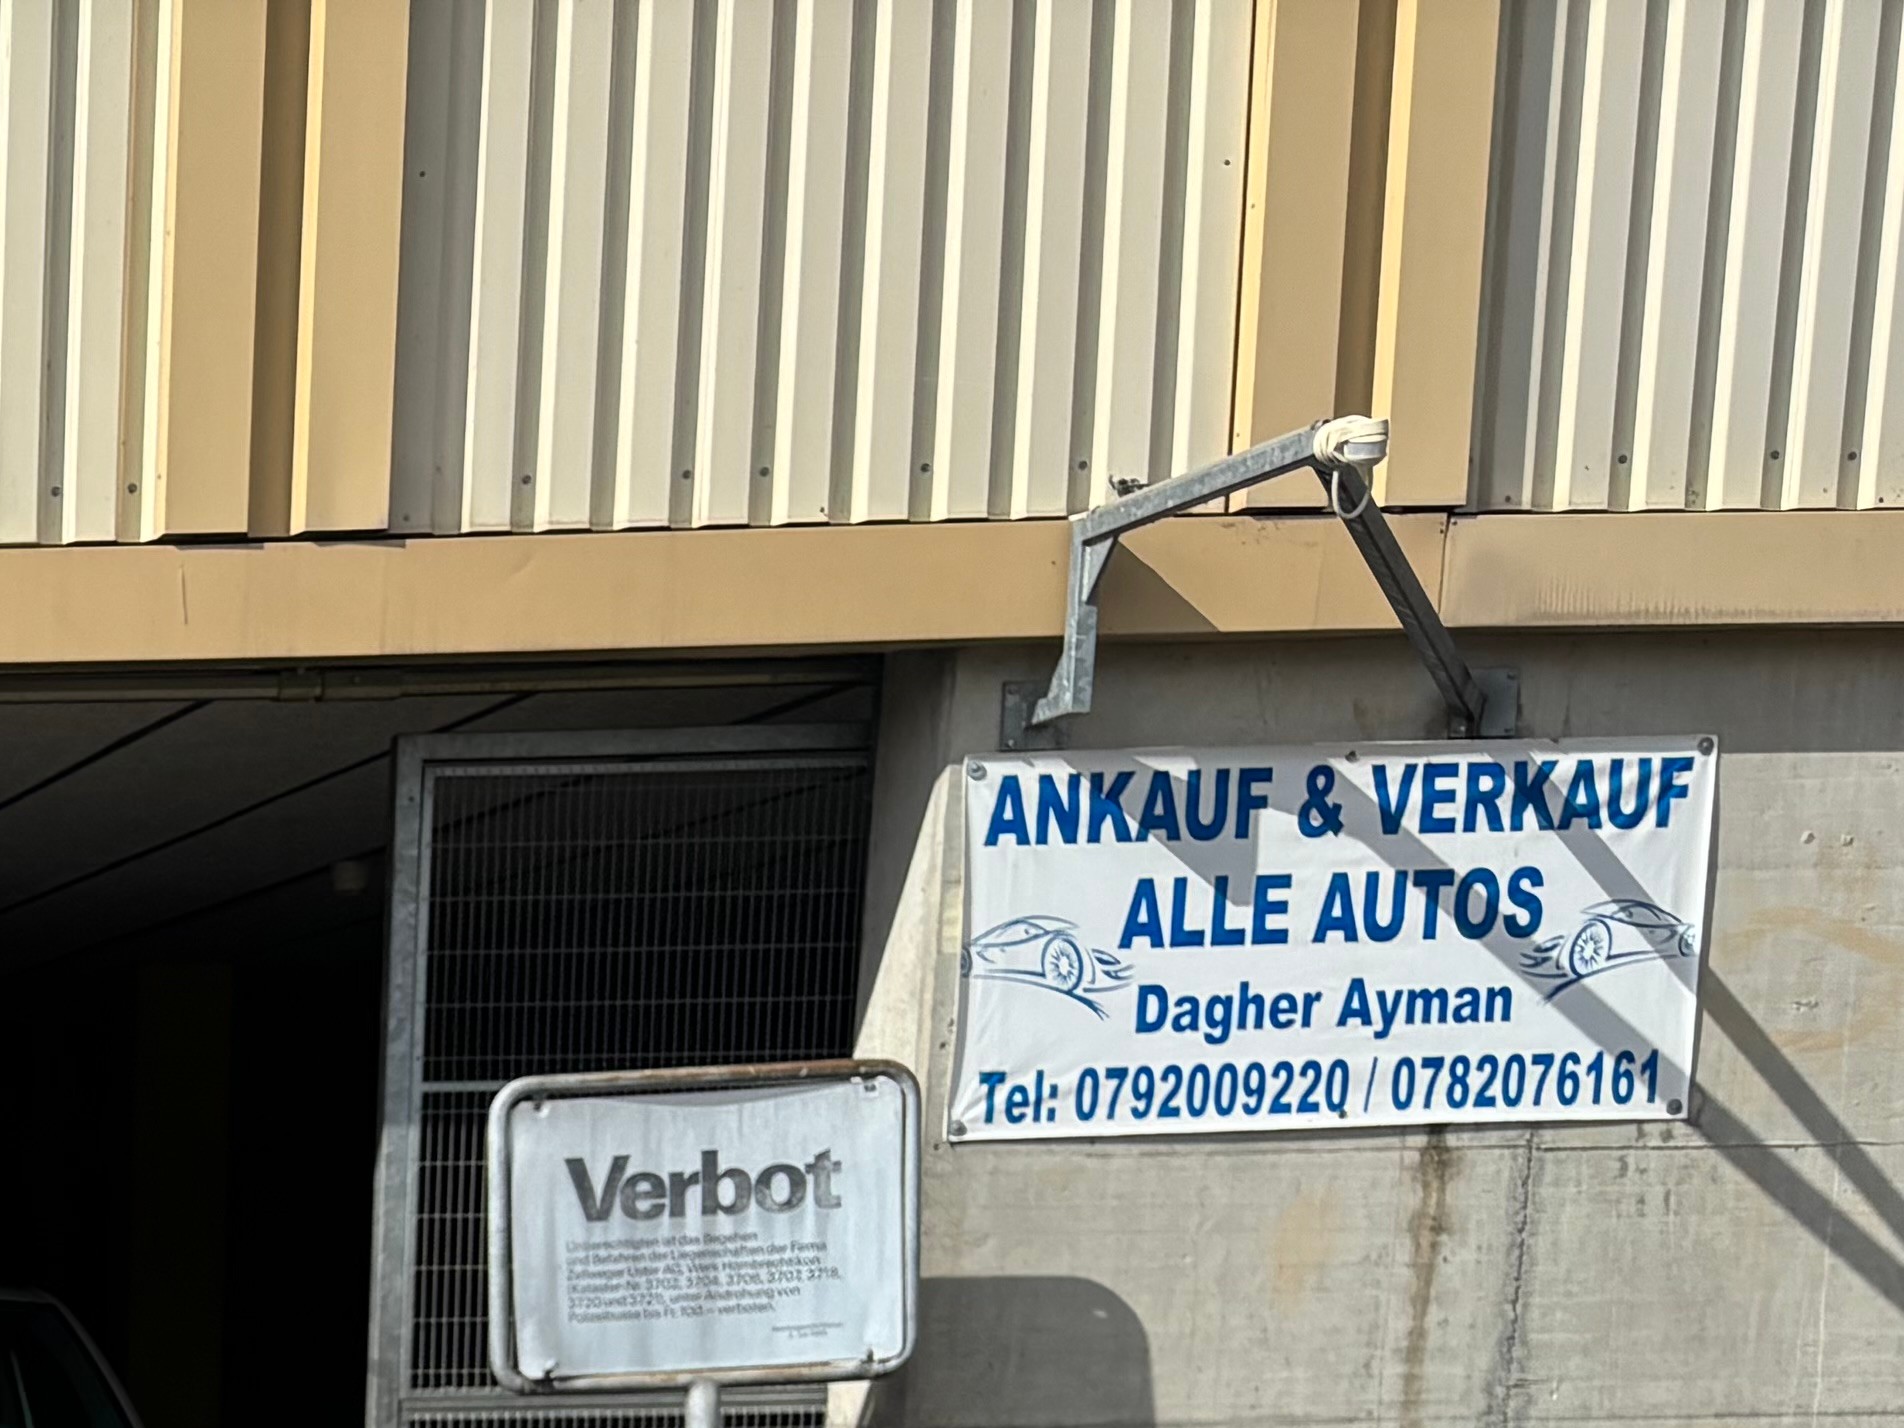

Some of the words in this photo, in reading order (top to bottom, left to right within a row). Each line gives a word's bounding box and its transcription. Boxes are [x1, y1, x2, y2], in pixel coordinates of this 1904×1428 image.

[983, 766, 1273, 847] ANKAUF
[1297, 764, 1344, 838] &
[1371, 755, 1696, 835] VERKAUF
[1118, 873, 1292, 950] ALLE
[1312, 866, 1546, 944] AUTOS
[1135, 983, 1322, 1044] Dagher
[1335, 978, 1512, 1044] Ayman
[978, 1069, 1057, 1125] Tel:
[1074, 1056, 1349, 1122] 0792009220
[1363, 1056, 1379, 1114] /
[1391, 1049, 1660, 1111] 0782076161
[564, 1148, 843, 1222] Verbot
